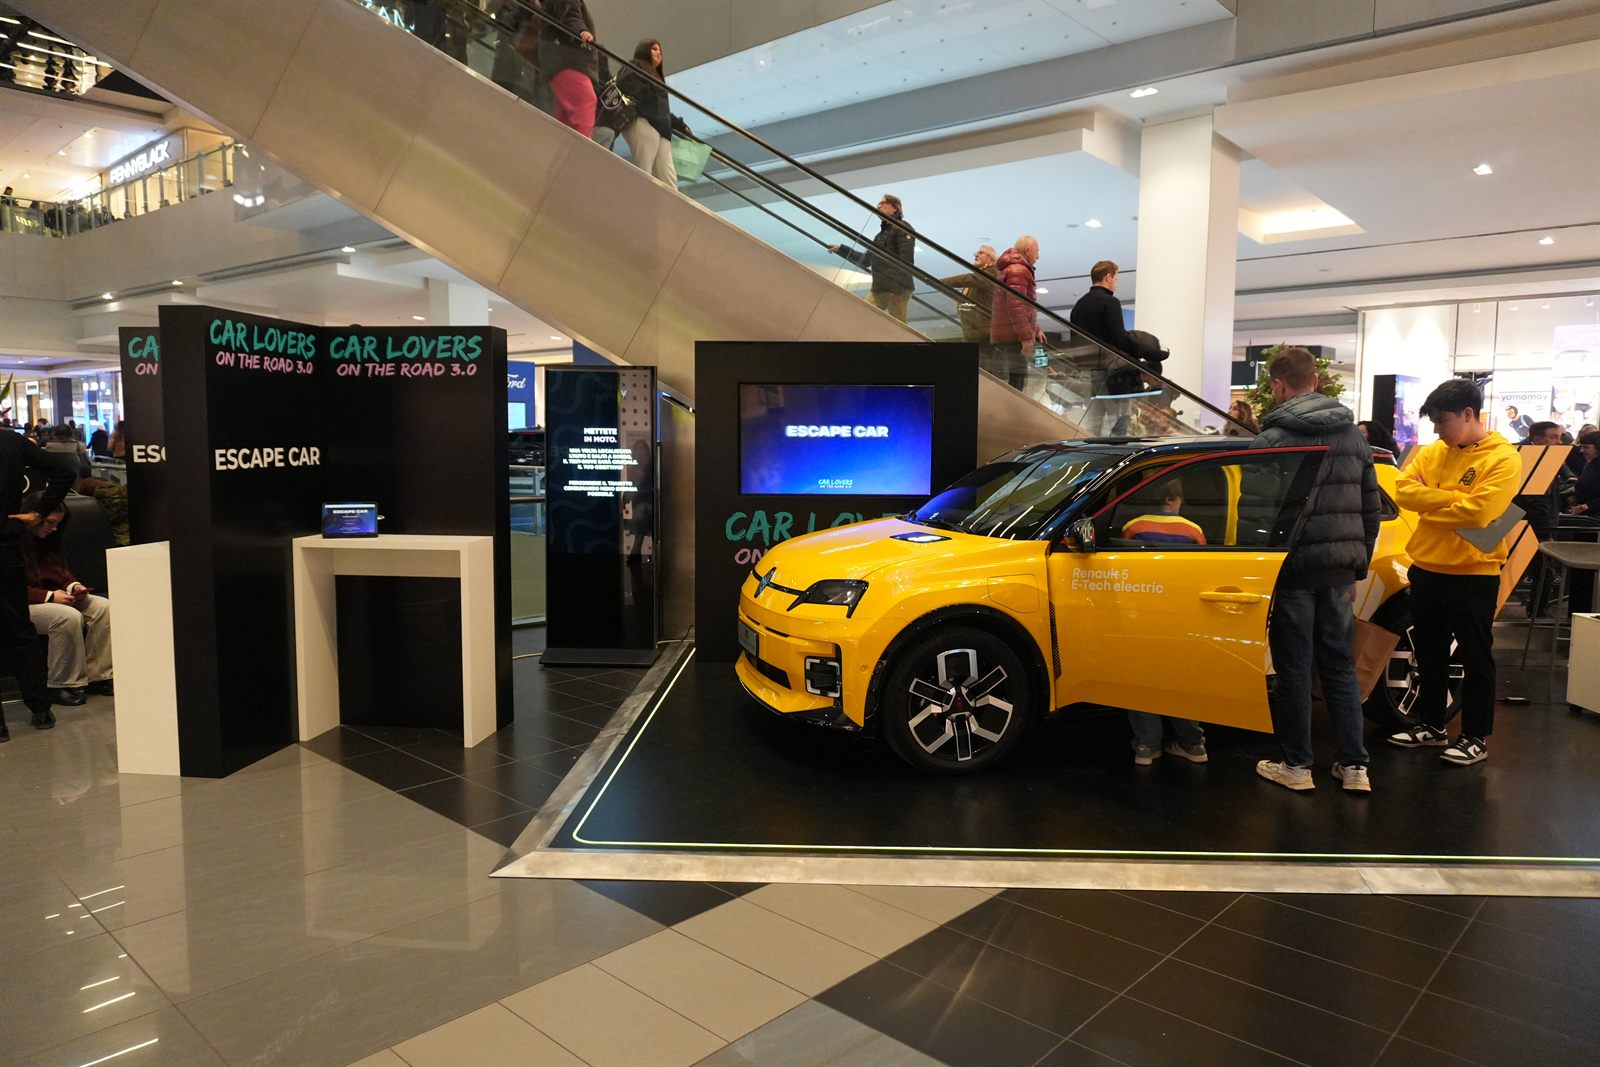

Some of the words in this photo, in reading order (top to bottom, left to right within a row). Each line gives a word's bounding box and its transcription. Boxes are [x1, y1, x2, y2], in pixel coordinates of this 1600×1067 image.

[110, 141, 169, 183] PENNYBLACK
[209, 319, 249, 352] CAR
[253, 324, 316, 359] LOVERS
[329, 335, 380, 362] CAR
[385, 335, 483, 361] LOVERS
[135, 363, 159, 375] ON
[215, 351, 234, 367] ON
[237, 353, 260, 369] THE
[263, 356, 293, 373] ROAD
[296, 360, 314, 374] 3.0
[336, 363, 360, 377] ON
[364, 363, 396, 377] THE
[400, 363, 445, 378] ROAD
[450, 363, 477, 377] 3.0
[1501, 393, 1548, 401] yamamay
[583, 427, 617, 435] METTETE
[785, 425, 851, 437] ESCAPE
[853, 425, 889, 437] CAR
[214, 447, 285, 471] ESCAPE
[288, 447, 321, 467] CAR
[725, 510, 794, 546] CAR
[1072, 567, 1120, 579] Renault
[1121, 569, 1129, 580] 5
[1071, 579, 1111, 591] E-Tech
[1113, 580, 1164, 594] electric
